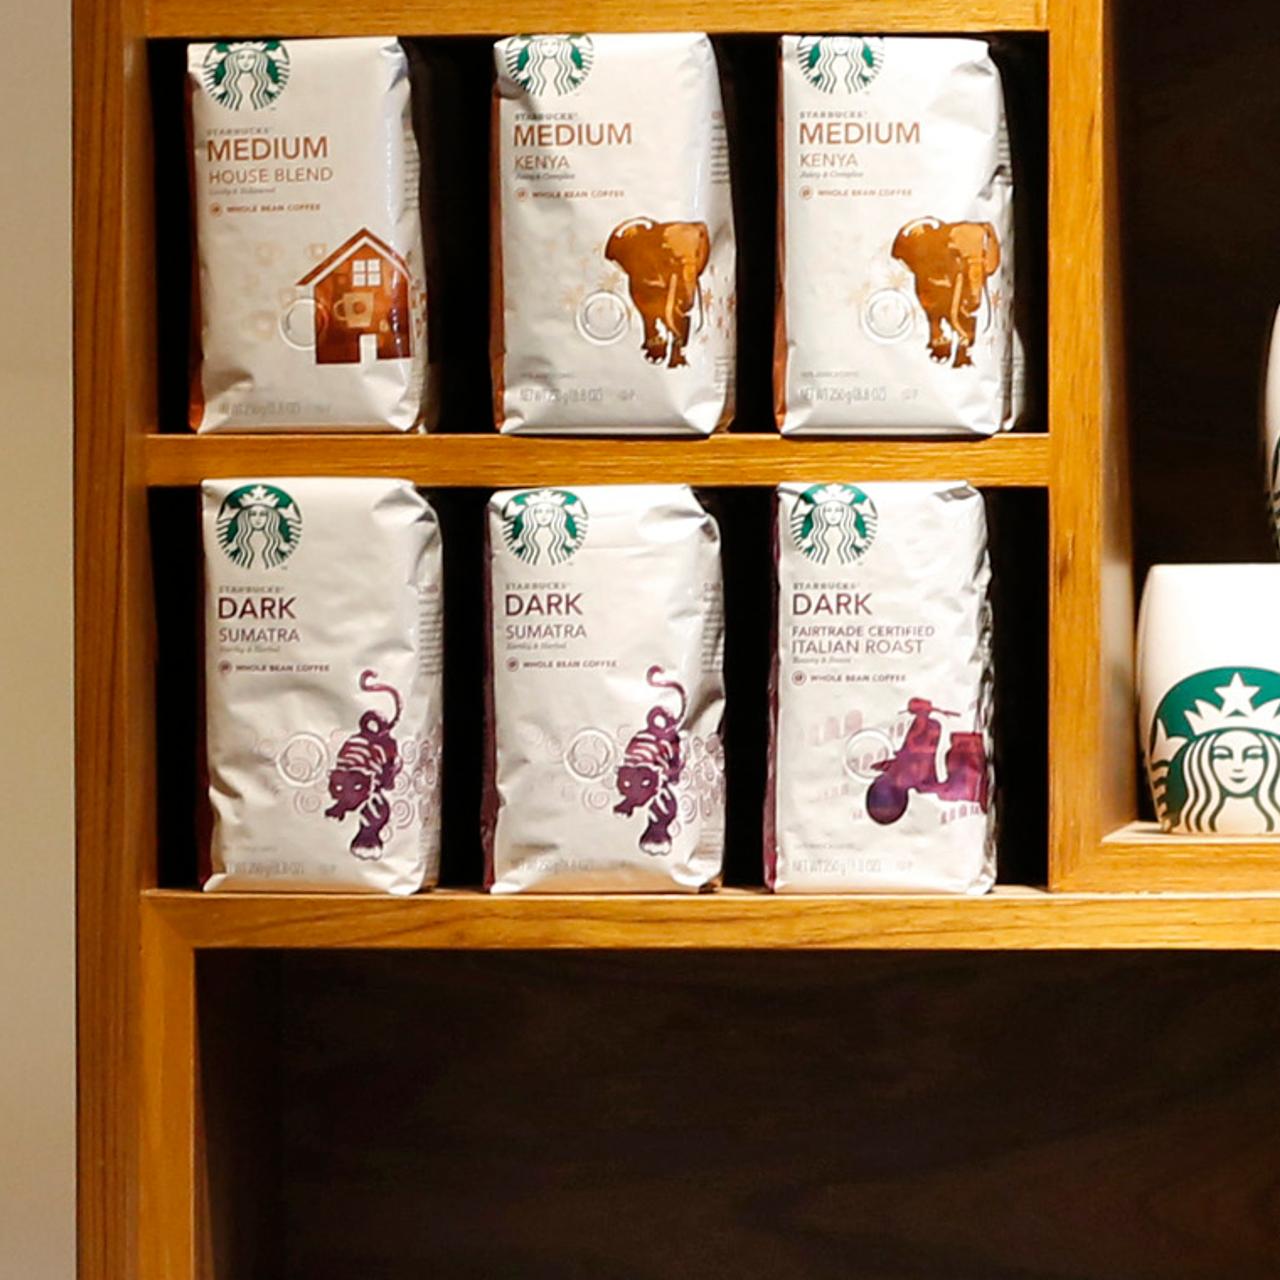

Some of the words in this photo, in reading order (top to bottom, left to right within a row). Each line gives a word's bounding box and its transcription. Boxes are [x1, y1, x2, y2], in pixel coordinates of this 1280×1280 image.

[513, 122, 632, 147] MEDIUM
[798, 122, 921, 145] MEDIUM
[206, 136, 329, 162] MEDIUM
[514, 155, 570, 170] KENYA
[799, 153, 858, 168] KENYA
[208, 168, 269, 185] HOUSE
[274, 166, 333, 183] BLEND
[591, 189, 625, 197] COFFEE
[217, 597, 297, 620] DARK
[505, 593, 583, 616] DARK
[792, 593, 873, 616] DARK
[218, 627, 300, 643] SUMATRA
[505, 624, 588, 640] SUMATRA
[791, 625, 864, 637] FAIRTRADE
[868, 625, 936, 637] CERTIFIED
[791, 639, 860, 654] ITALIAN
[865, 639, 924, 654] ROAST
